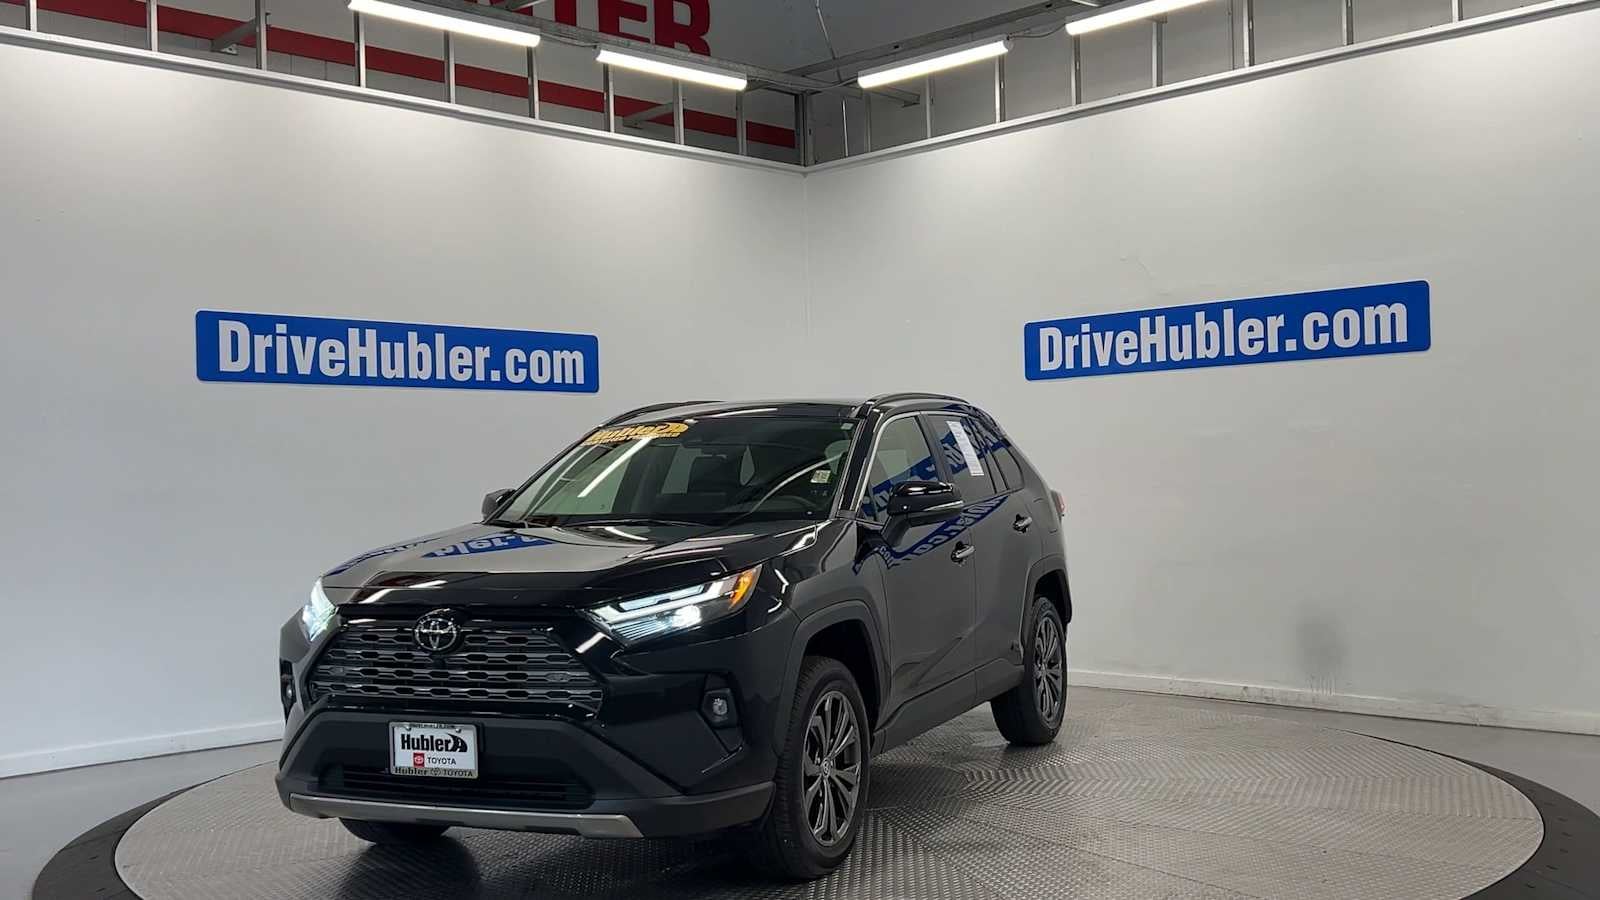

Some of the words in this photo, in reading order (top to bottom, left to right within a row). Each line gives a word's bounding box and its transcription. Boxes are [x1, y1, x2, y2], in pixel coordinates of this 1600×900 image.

[218, 319, 584, 384] DriveHubler.com
[1039, 301, 1408, 371] DriveHubler.com
[401, 733, 453, 752] Hubler
[427, 756, 457, 766] TOYOTA
